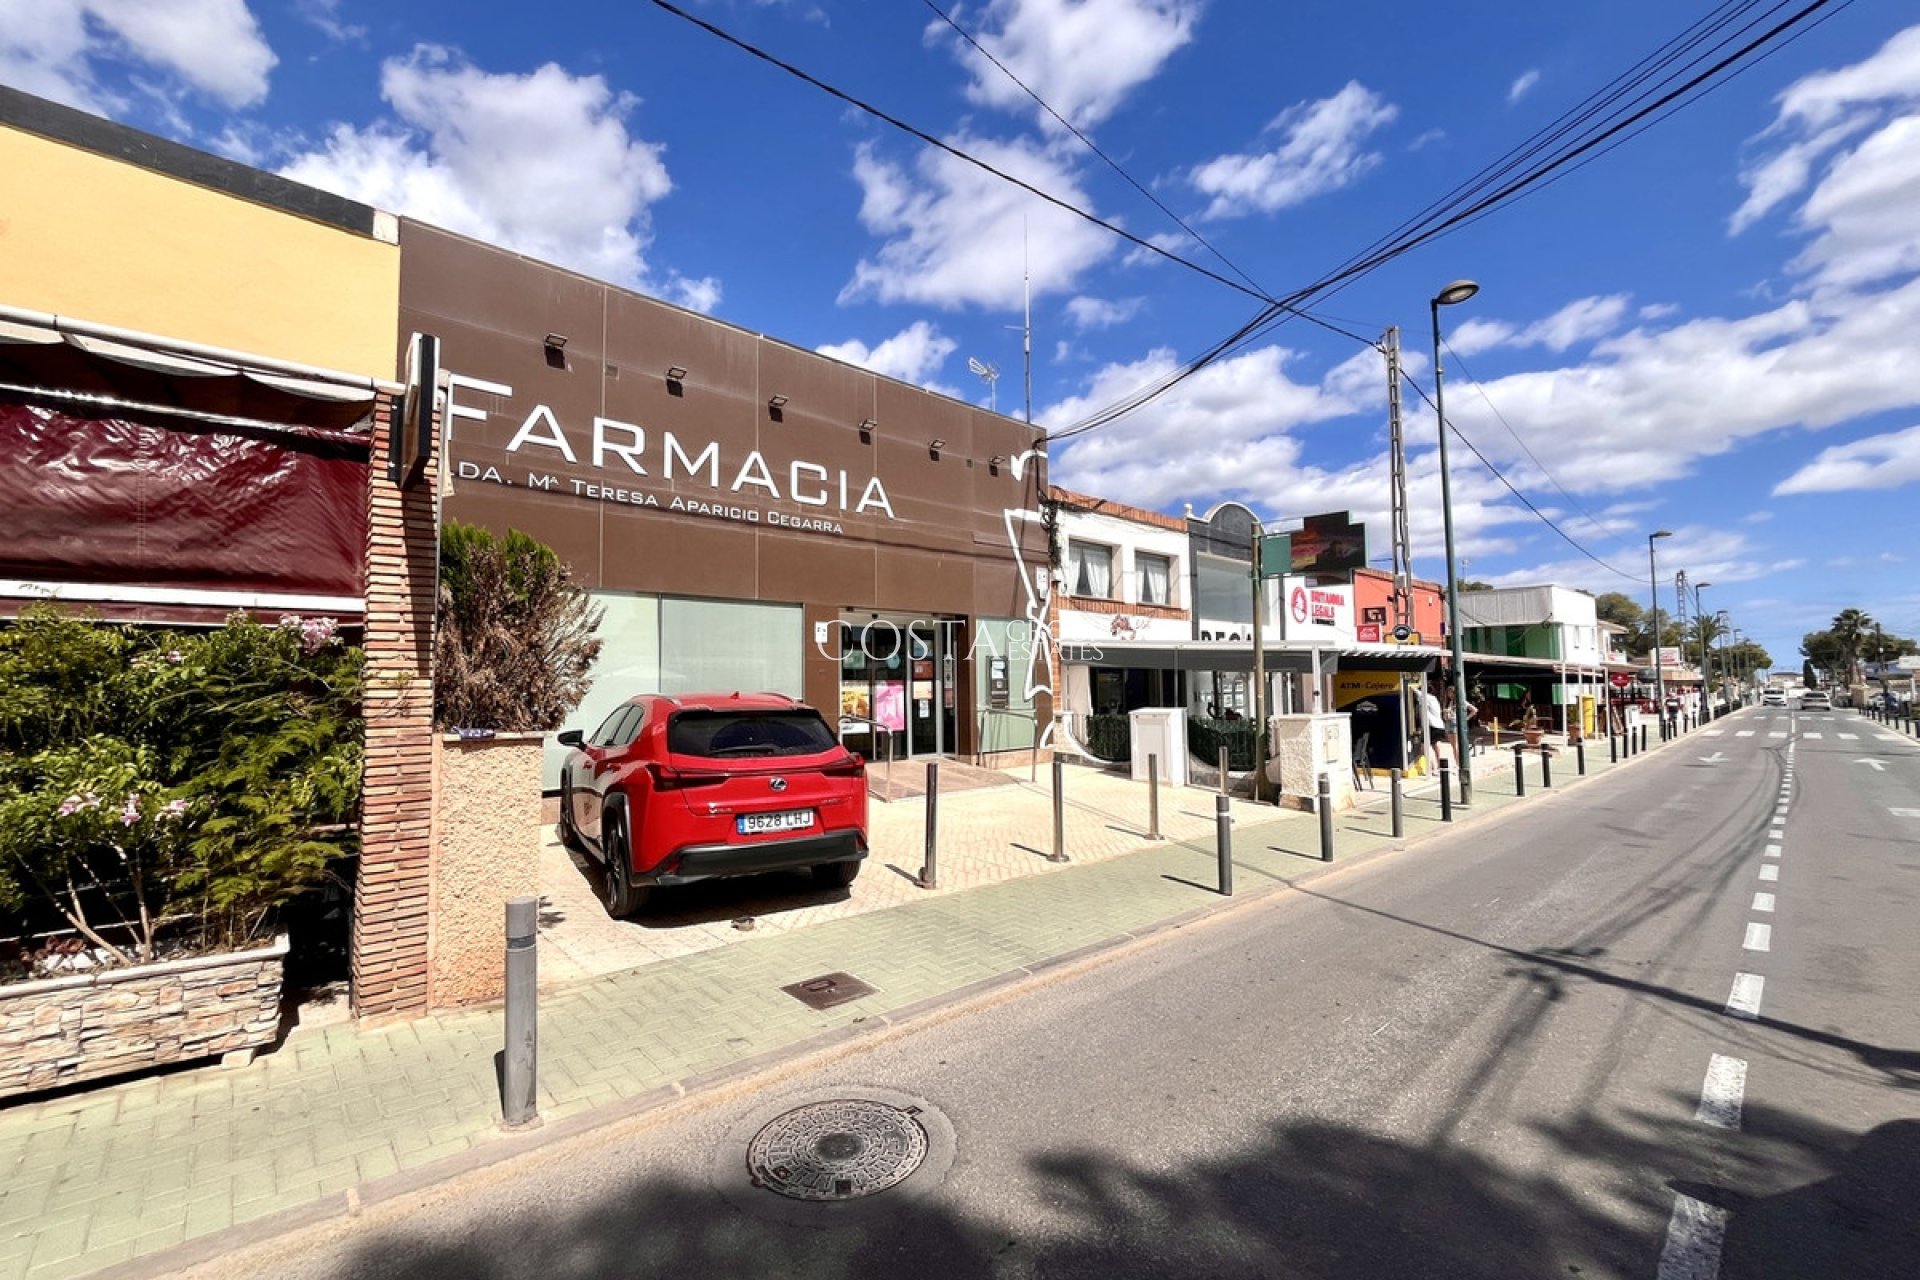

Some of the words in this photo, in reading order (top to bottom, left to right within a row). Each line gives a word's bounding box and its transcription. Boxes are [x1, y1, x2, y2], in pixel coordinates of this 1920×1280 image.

[447, 373, 895, 519] FARMACIA
[450, 461, 513, 485] DA.
[570, 479, 659, 507] TERESA
[670, 495, 760, 522] APARICIO
[767, 510, 844, 534] CEGARRA
[748, 814, 782, 829] 9628
[785, 810, 811, 826] LHJ
